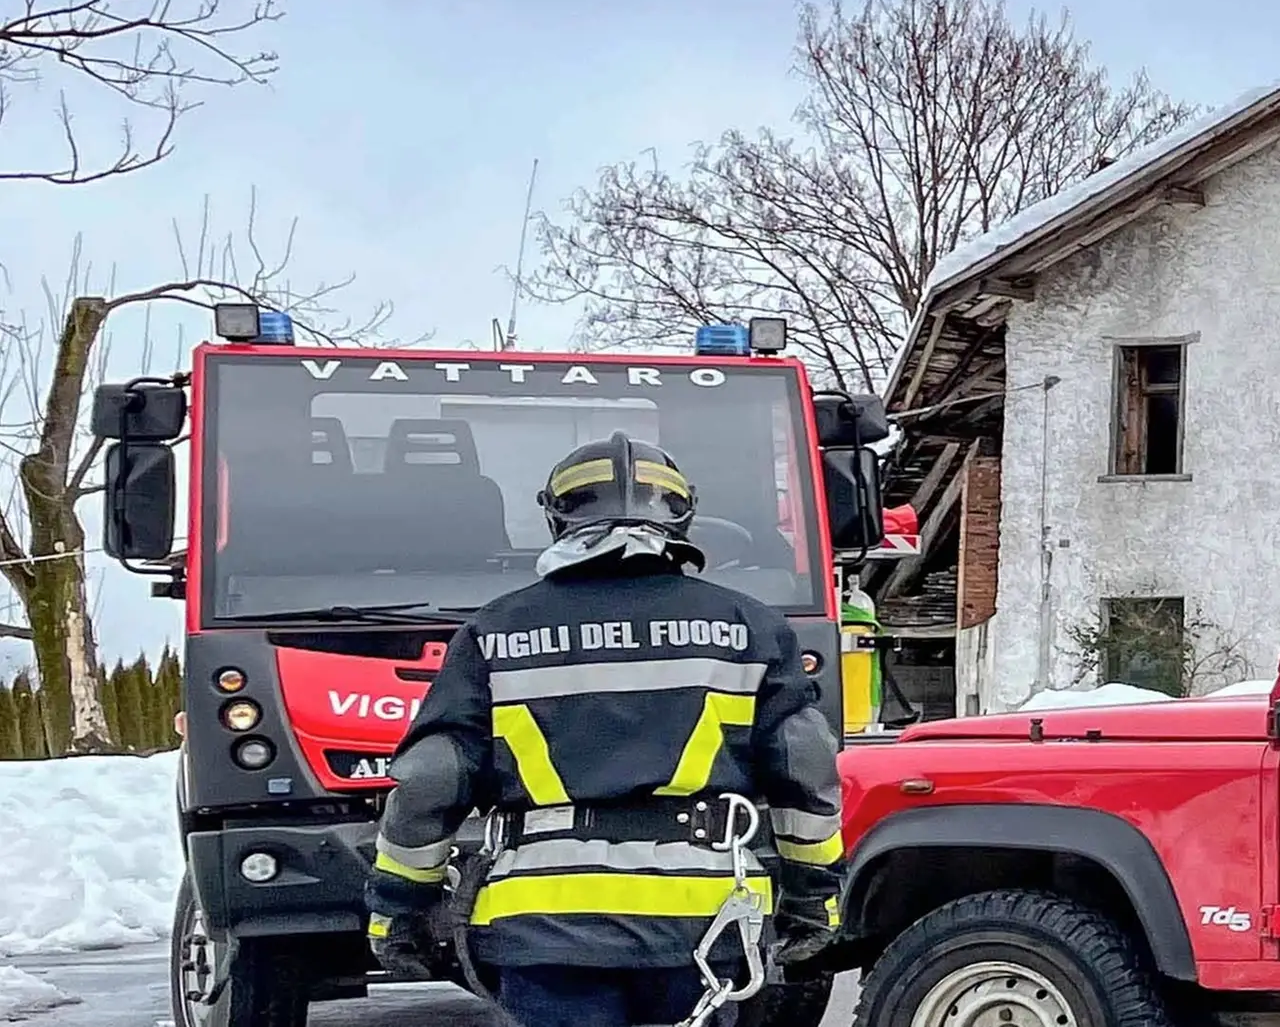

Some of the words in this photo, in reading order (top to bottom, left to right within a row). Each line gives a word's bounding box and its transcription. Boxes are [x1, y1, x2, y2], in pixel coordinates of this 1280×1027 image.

[300, 360, 727, 387] VATTARO
[477, 625, 571, 661] VIGILI
[580, 621, 640, 650] DEL
[650, 619, 749, 652] FUOCO
[1199, 905, 1251, 932] Td5
